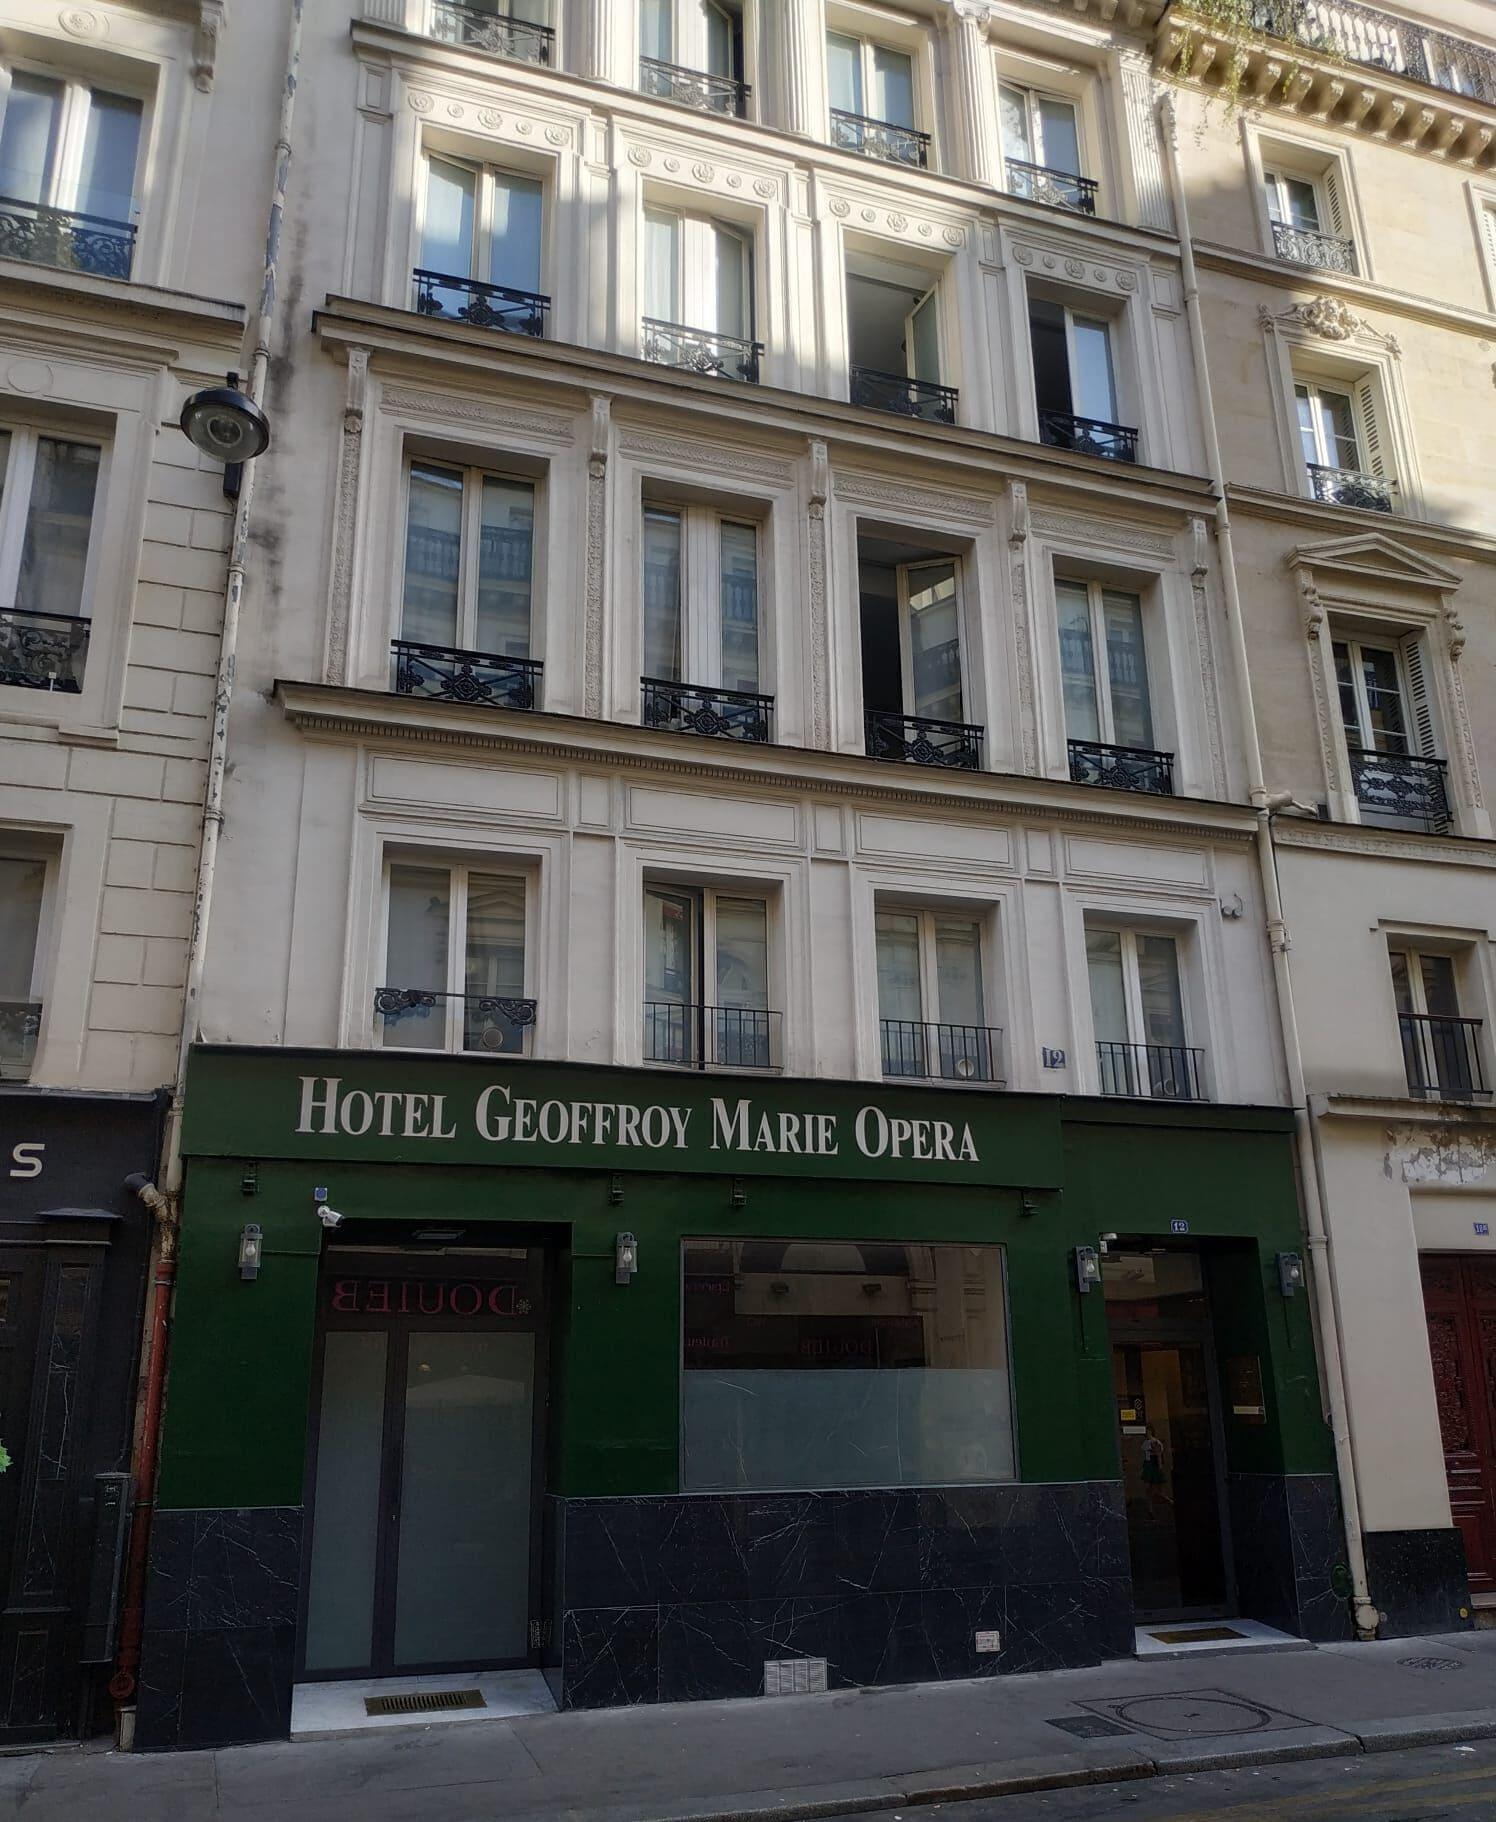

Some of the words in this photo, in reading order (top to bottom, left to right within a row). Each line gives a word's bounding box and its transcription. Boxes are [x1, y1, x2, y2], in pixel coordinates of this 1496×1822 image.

[1045, 1050, 1064, 1067] 12
[295, 1076, 457, 1139] HOTEL
[475, 1085, 692, 1149] GEOFFROY
[710, 1097, 839, 1155] MARIE
[855, 1105, 980, 1161] OPERA
